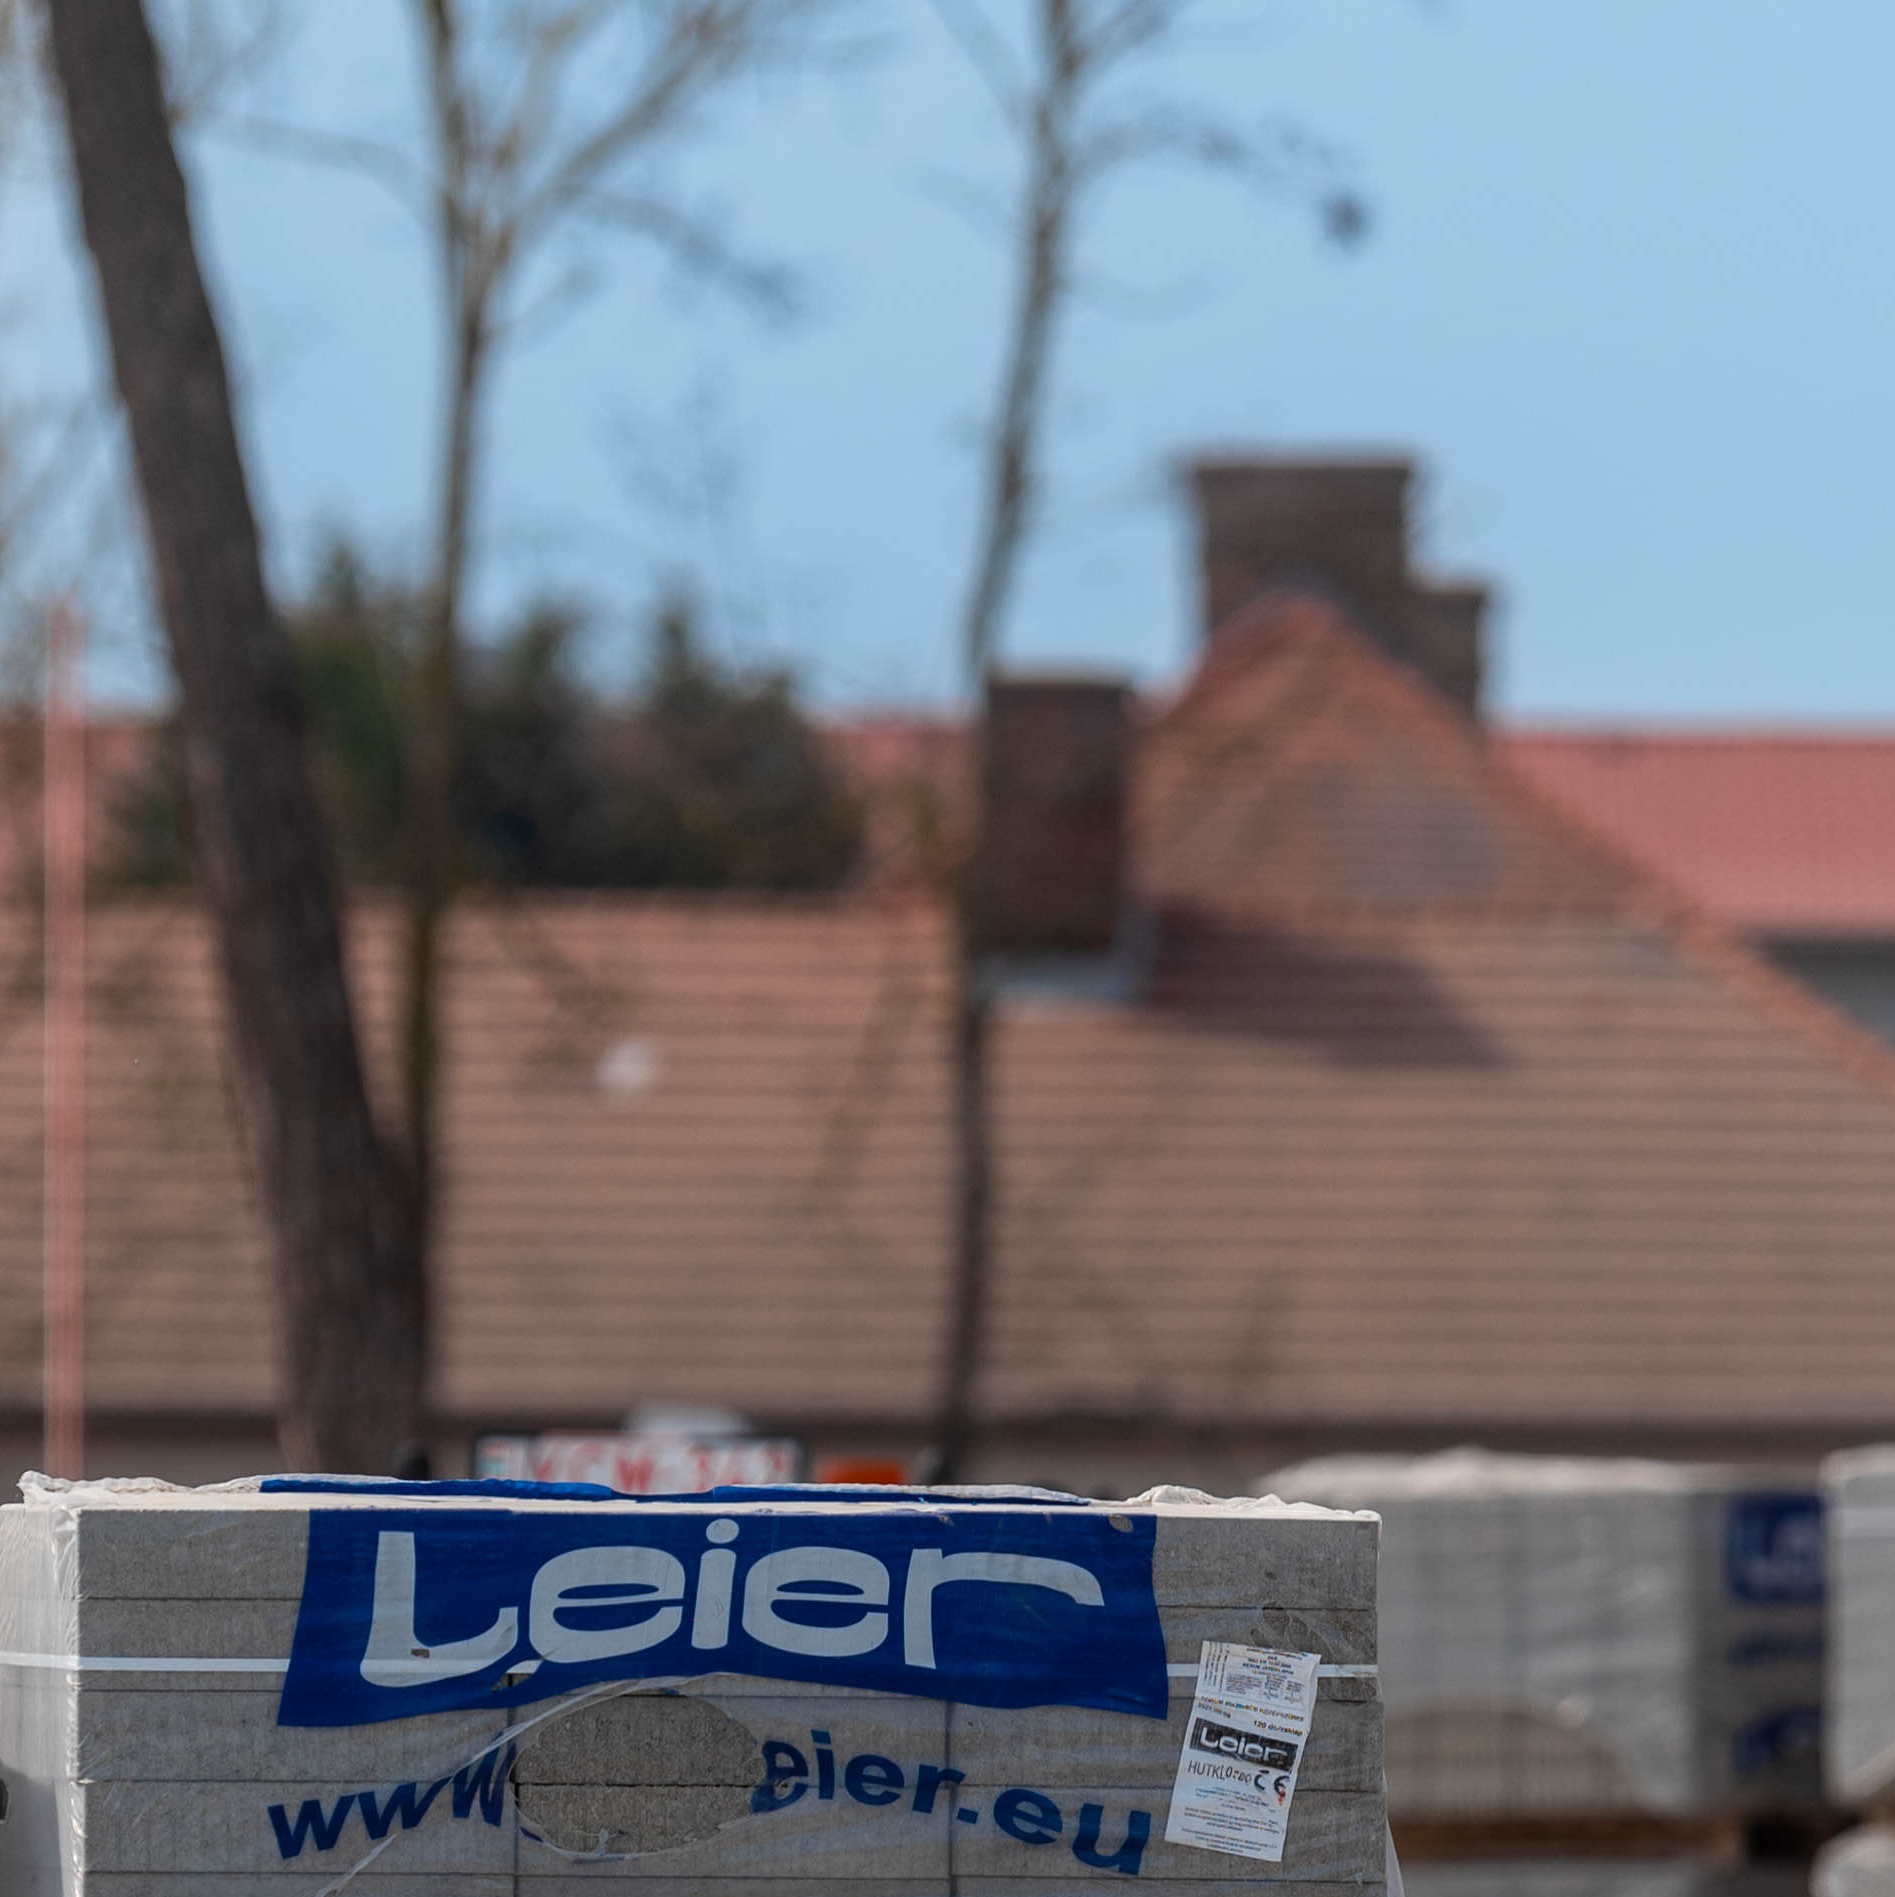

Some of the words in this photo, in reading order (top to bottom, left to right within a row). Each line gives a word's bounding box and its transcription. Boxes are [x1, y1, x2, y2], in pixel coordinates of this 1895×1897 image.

[358, 1518, 1106, 1685] Leier
[266, 1729, 1152, 1876] wwweier.eu
[1200, 1726, 1288, 1762] Leier
